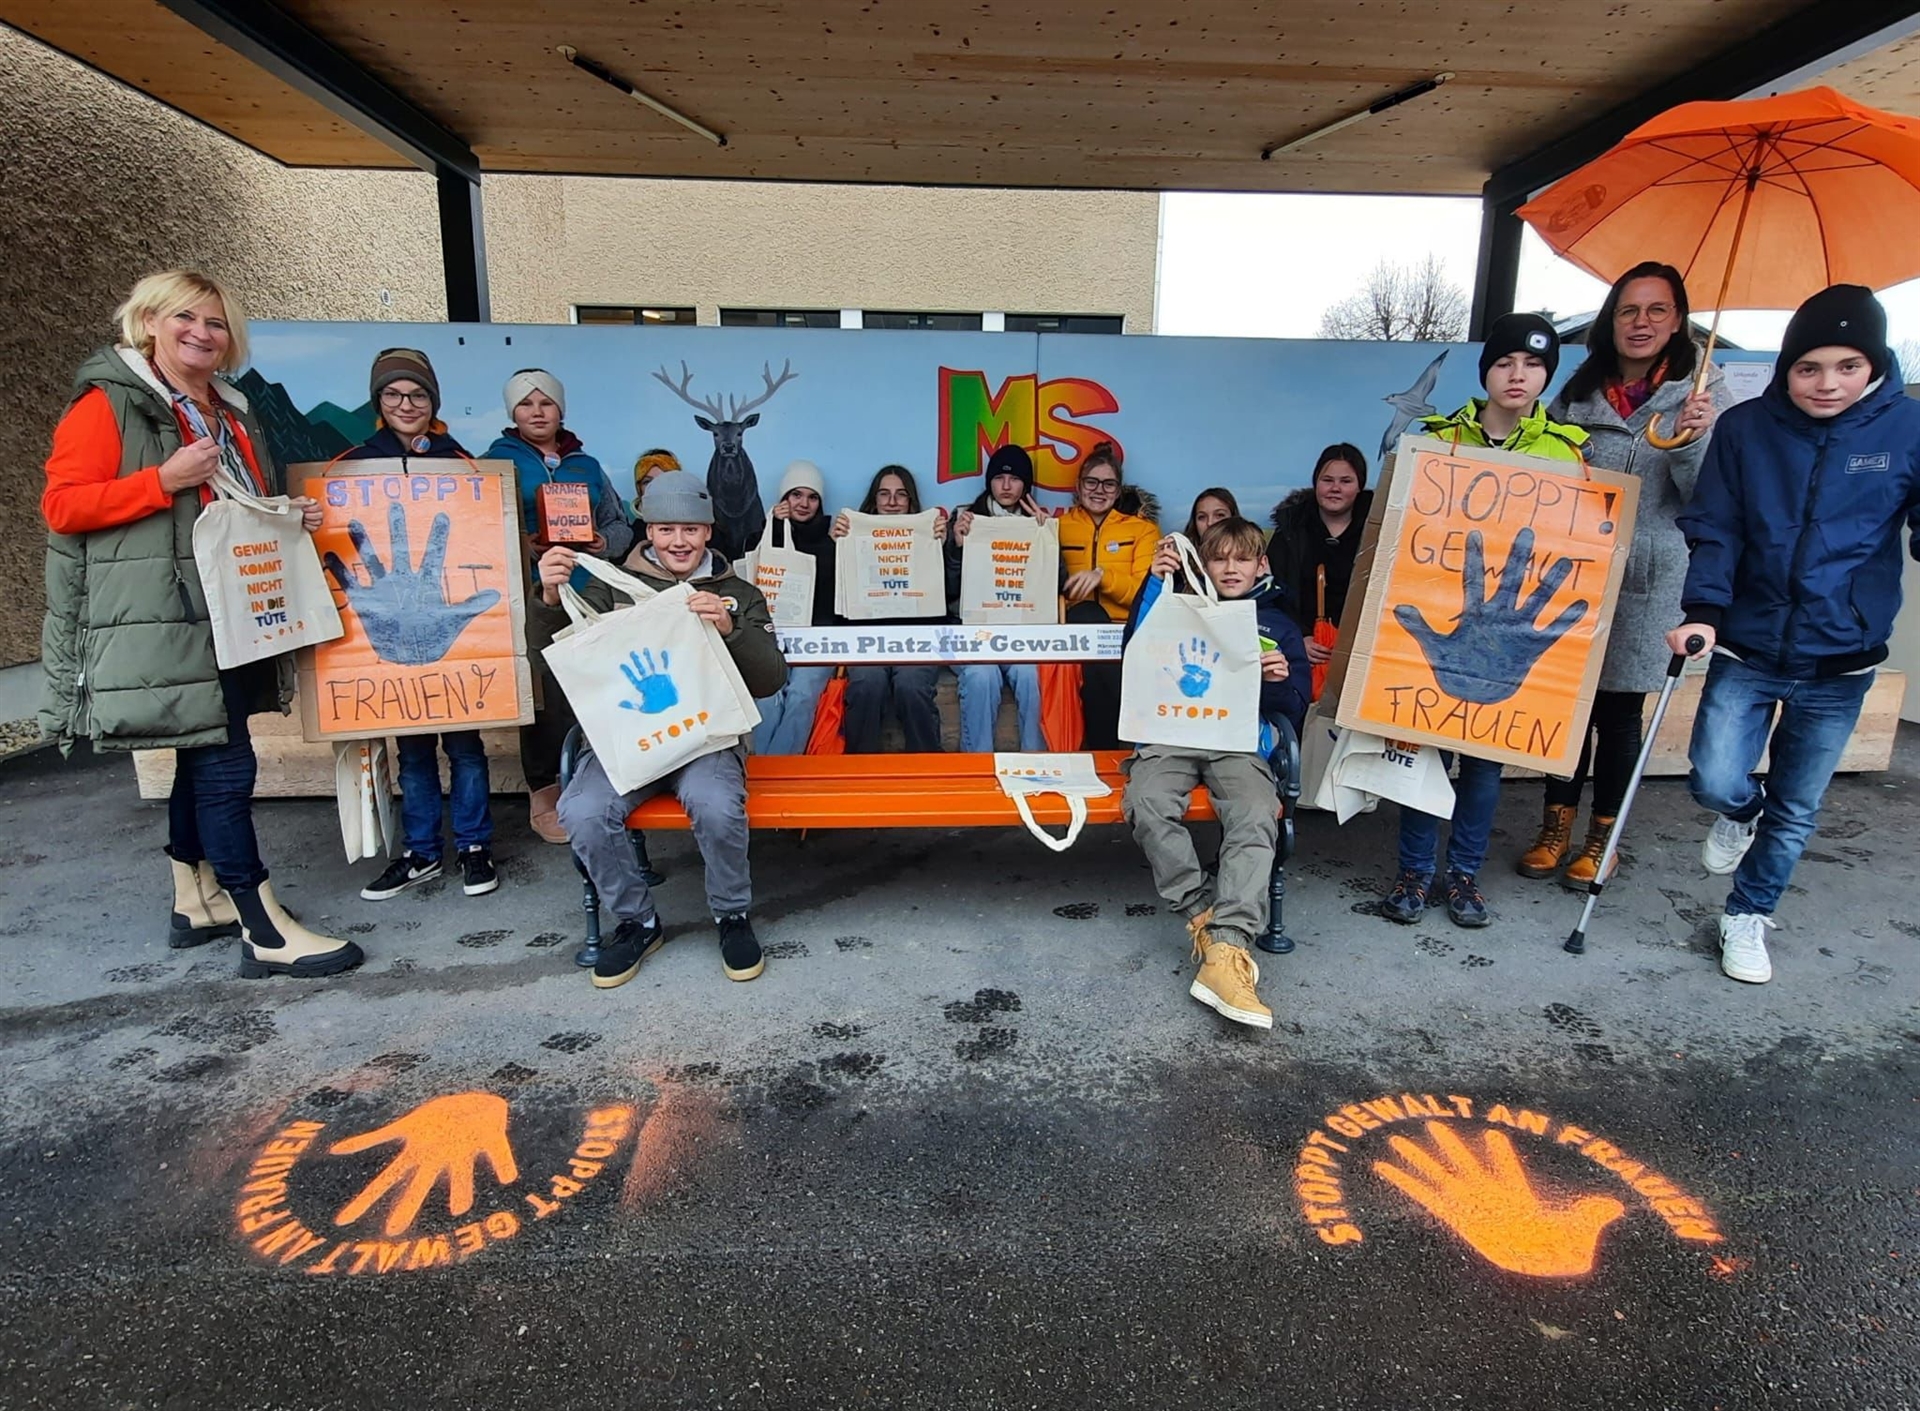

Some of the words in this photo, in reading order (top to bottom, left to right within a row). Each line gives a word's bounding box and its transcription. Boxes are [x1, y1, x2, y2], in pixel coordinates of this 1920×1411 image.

[938, 366, 1124, 492] MS
[326, 476, 485, 506] STOPPT
[544, 484, 588, 495] ORANGE
[548, 515, 590, 527] WORLD
[872, 529, 914, 538] GEWALT
[232, 540, 278, 558] GEWALT
[874, 542, 912, 551] KOMMT
[991, 541, 1031, 551] GEWALT
[878, 555, 910, 563] NICHT
[992, 554, 1030, 564] KOMMT
[239, 560, 282, 577] KOMMT
[880, 567, 890, 576] IN
[893, 567, 909, 576] DIE
[995, 566, 1026, 576] NICHT
[247, 578, 283, 595] NICHT
[755, 578, 783, 589] OMMT
[882, 578, 909, 589] TÜTE
[995, 579, 1005, 588] IN
[1008, 580, 1025, 589] DIE
[995, 590, 1022, 601] TÜTE
[251, 601, 264, 613] IN
[267, 597, 285, 610] DIE
[255, 612, 287, 627] TÜTE
[783, 637, 849, 654] Kein
[857, 636, 932, 654] Platz
[939, 635, 982, 653] für
[990, 634, 1090, 652] Gewalt
[326, 664, 496, 721] FRAUEN!
[1157, 704, 1228, 721] STOPP
[1384, 686, 1562, 757] FRAUEN
[638, 712, 708, 751] STOPP
[1397, 740, 1420, 755] DIE
[1325, 1094, 1472, 1138] GEWALT
[1487, 1104, 1550, 1135] AN
[238, 1121, 325, 1233] FRAUEN
[1558, 1126, 1725, 1241] FRAUEN
[1296, 1130, 1363, 1245] STOPPT
[253, 1220, 327, 1265] AN
[305, 1211, 519, 1274] GEWALT
